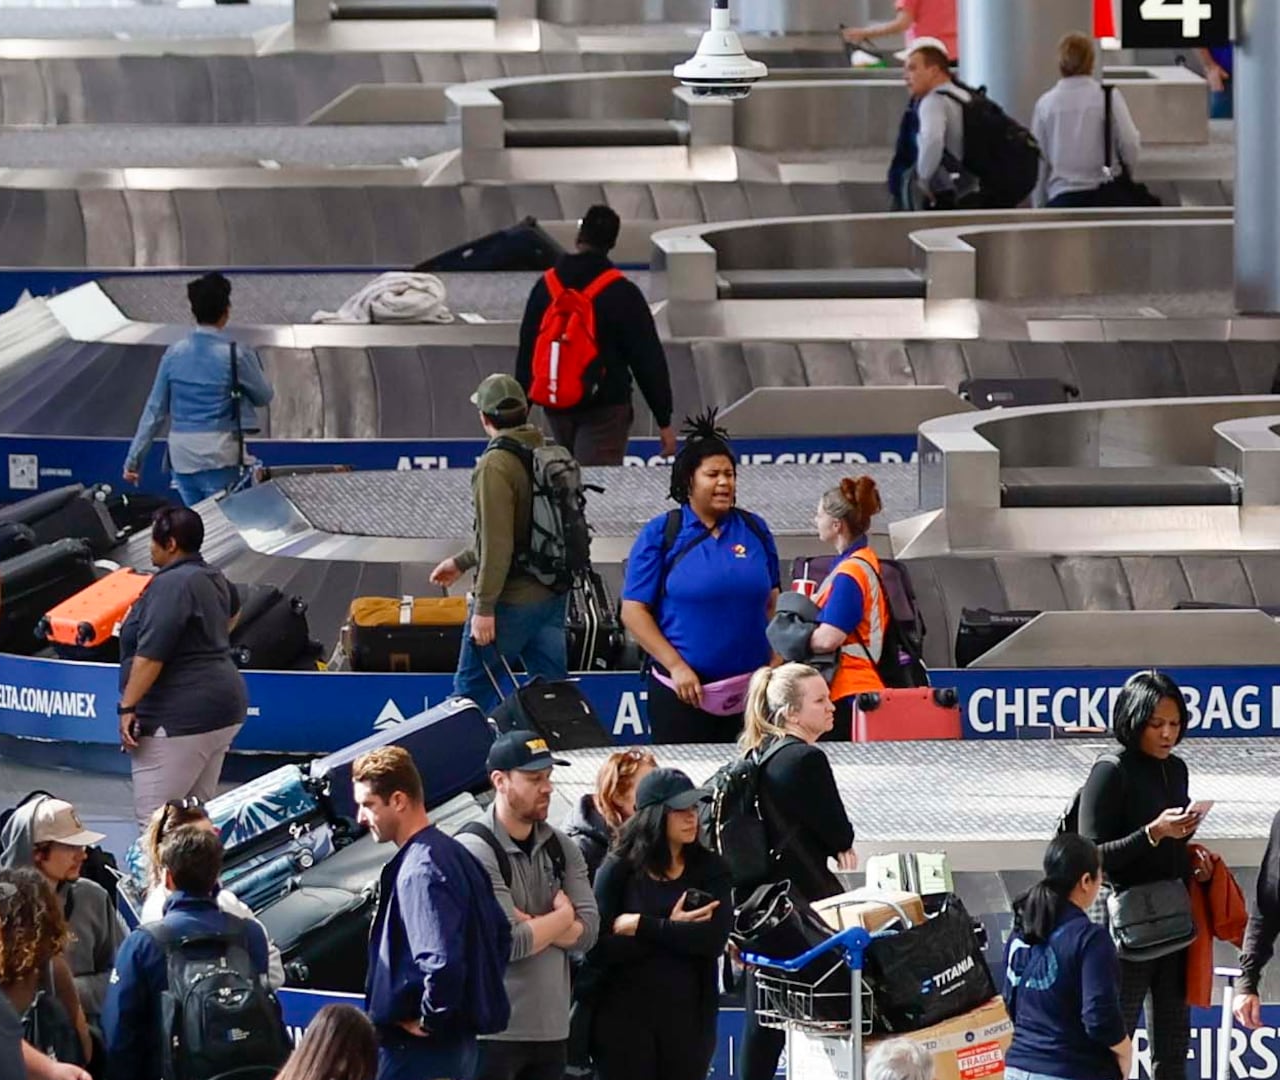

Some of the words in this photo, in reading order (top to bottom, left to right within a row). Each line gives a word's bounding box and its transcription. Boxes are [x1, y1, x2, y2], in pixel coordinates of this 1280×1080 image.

[968, 686, 1118, 732] CHECK
[1182, 684, 1261, 730] BAG
[932, 955, 975, 988] TITANIA
[960, 1051, 1001, 1069] FRAGILE
